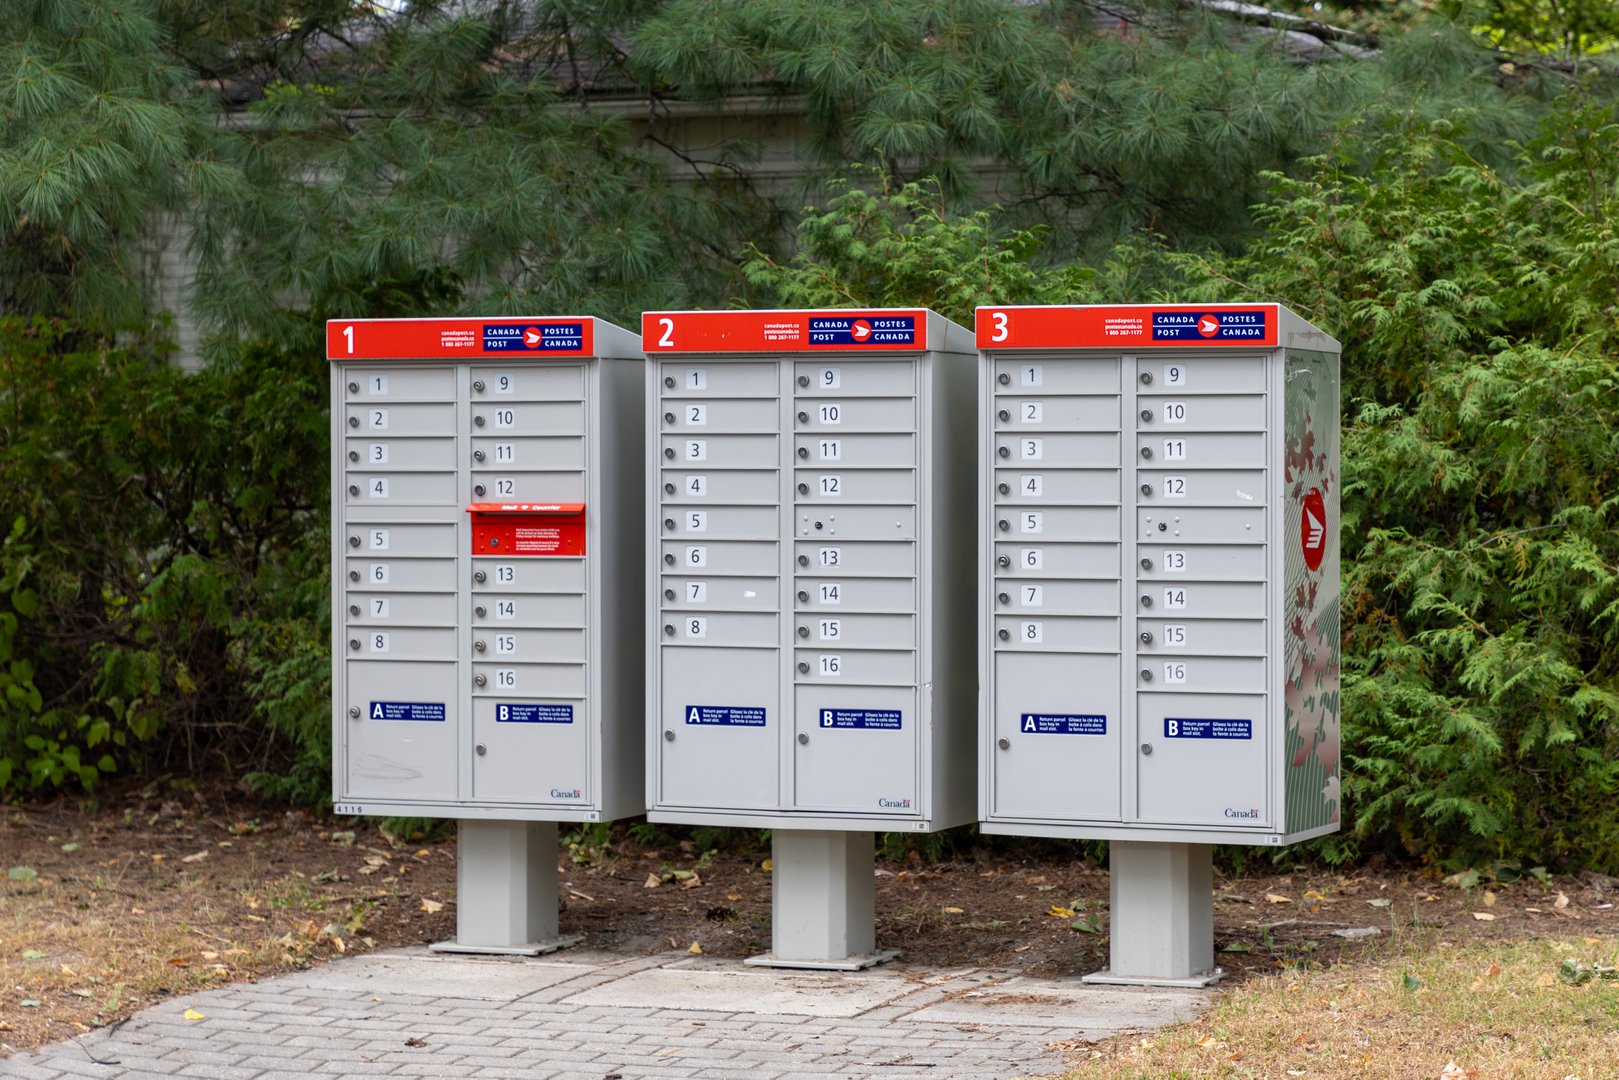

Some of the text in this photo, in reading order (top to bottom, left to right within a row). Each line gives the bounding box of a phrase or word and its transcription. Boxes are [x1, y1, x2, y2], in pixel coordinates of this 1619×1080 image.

[1157, 316, 1195, 324] CANADA
[658, 318, 674, 347] 2
[991, 313, 1008, 342] 3
[343, 326, 354, 354] 1
[693, 372, 698, 385] 1
[825, 371, 834, 385] 9
[1029, 368, 1034, 382] 1
[1170, 368, 1179, 382] 9
[376, 378, 381, 390] 1
[500, 376, 508, 390] 9
[375, 412, 382, 425] 2
[497, 411, 513, 424] 10
[691, 408, 699, 421] 2
[822, 407, 838, 421] 10
[1027, 405, 1036, 419] 2
[1166, 405, 1185, 419] 10
[375, 447, 383, 460] 3
[497, 446, 511, 459] 11
[691, 443, 699, 457] 3
[822, 443, 836, 456] 11
[1027, 442, 1036, 456] 3
[1167, 442, 1182, 456] 11
[375, 481, 383, 494] 4
[498, 481, 513, 494] 12
[691, 479, 700, 492] 4
[822, 478, 838, 492] 12
[1027, 479, 1036, 492] 4
[1167, 480, 1184, 493] 12
[692, 514, 700, 528] 5
[1028, 515, 1036, 529] 5
[376, 532, 383, 546] 5
[691, 550, 700, 563] 6
[822, 551, 838, 565] 13
[1027, 551, 1036, 565] 6
[1167, 554, 1184, 568] 13
[375, 567, 384, 580] 6
[498, 568, 513, 581] 13
[691, 585, 699, 598] 7
[822, 587, 838, 600] 14
[1027, 588, 1036, 602] 7
[1167, 591, 1185, 605] 14
[376, 601, 383, 614] 7
[498, 602, 514, 615] 14
[691, 620, 700, 634] 8
[822, 623, 838, 636] 15
[1027, 625, 1036, 638] 8
[375, 635, 384, 648] 8
[1167, 628, 1184, 642] 15
[499, 637, 514, 651] 15
[822, 658, 838, 672] 16
[1167, 665, 1185, 679] 16
[499, 672, 514, 685] 16
[373, 704, 384, 718] A
[500, 706, 509, 720] B
[689, 708, 700, 723] A
[824, 711, 833, 726] B
[1024, 716, 1036, 731] A
[1169, 720, 1178, 736] B
[550, 789, 581, 799] Canada
[879, 798, 911, 808] Canada
[1224, 808, 1258, 818] Canada
